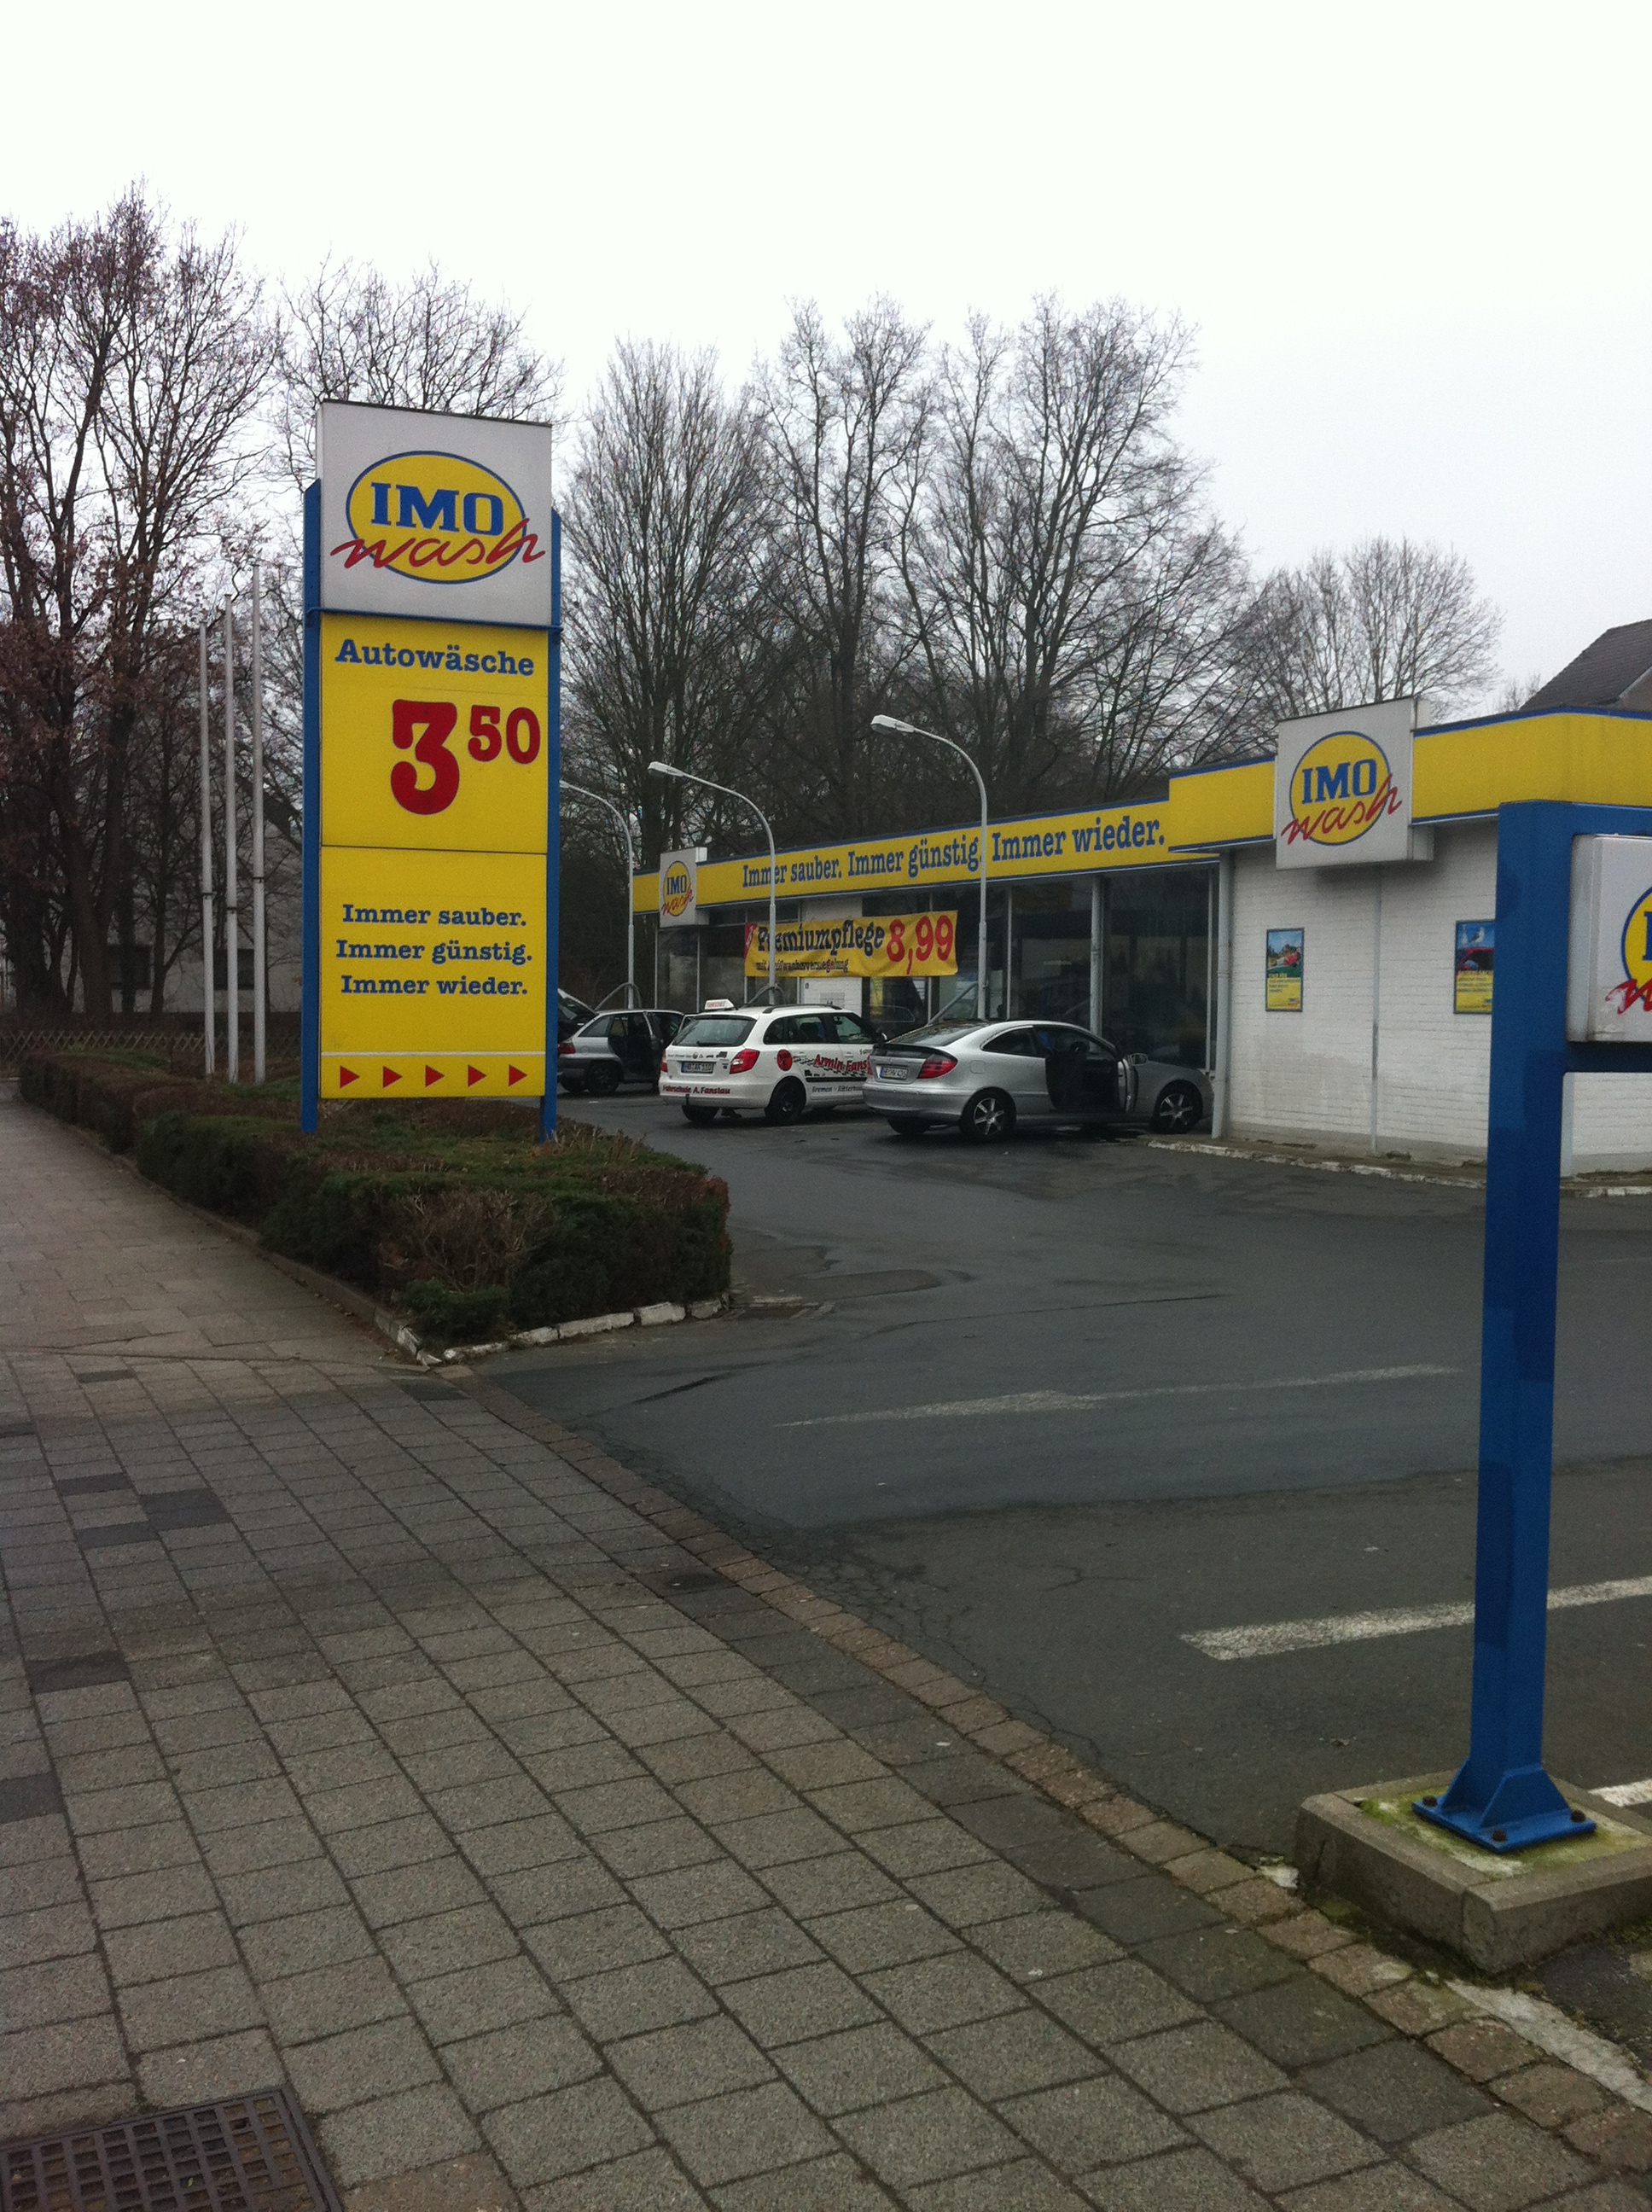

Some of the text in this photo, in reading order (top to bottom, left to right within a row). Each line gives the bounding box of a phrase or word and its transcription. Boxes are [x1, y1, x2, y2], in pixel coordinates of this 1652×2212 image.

[370, 482, 504, 536] IMO
[330, 518, 545, 569] wash
[335, 638, 534, 677] Autowäsche
[1302, 759, 1377, 805] IMO
[1281, 773, 1402, 845] wash
[742, 864, 787, 888] Immer
[790, 856, 842, 883] sauber.
[847, 850, 904, 876] Immer
[992, 830, 1067, 862] Immer
[1072, 815, 1165, 853] wieder.
[666, 875, 687, 895] IMO
[342, 904, 527, 927] Immer sauber.
[336, 940, 532, 966] Immer günstig.
[887, 915, 954, 975] 8,99
[340, 975, 528, 996] Immer wieder.
